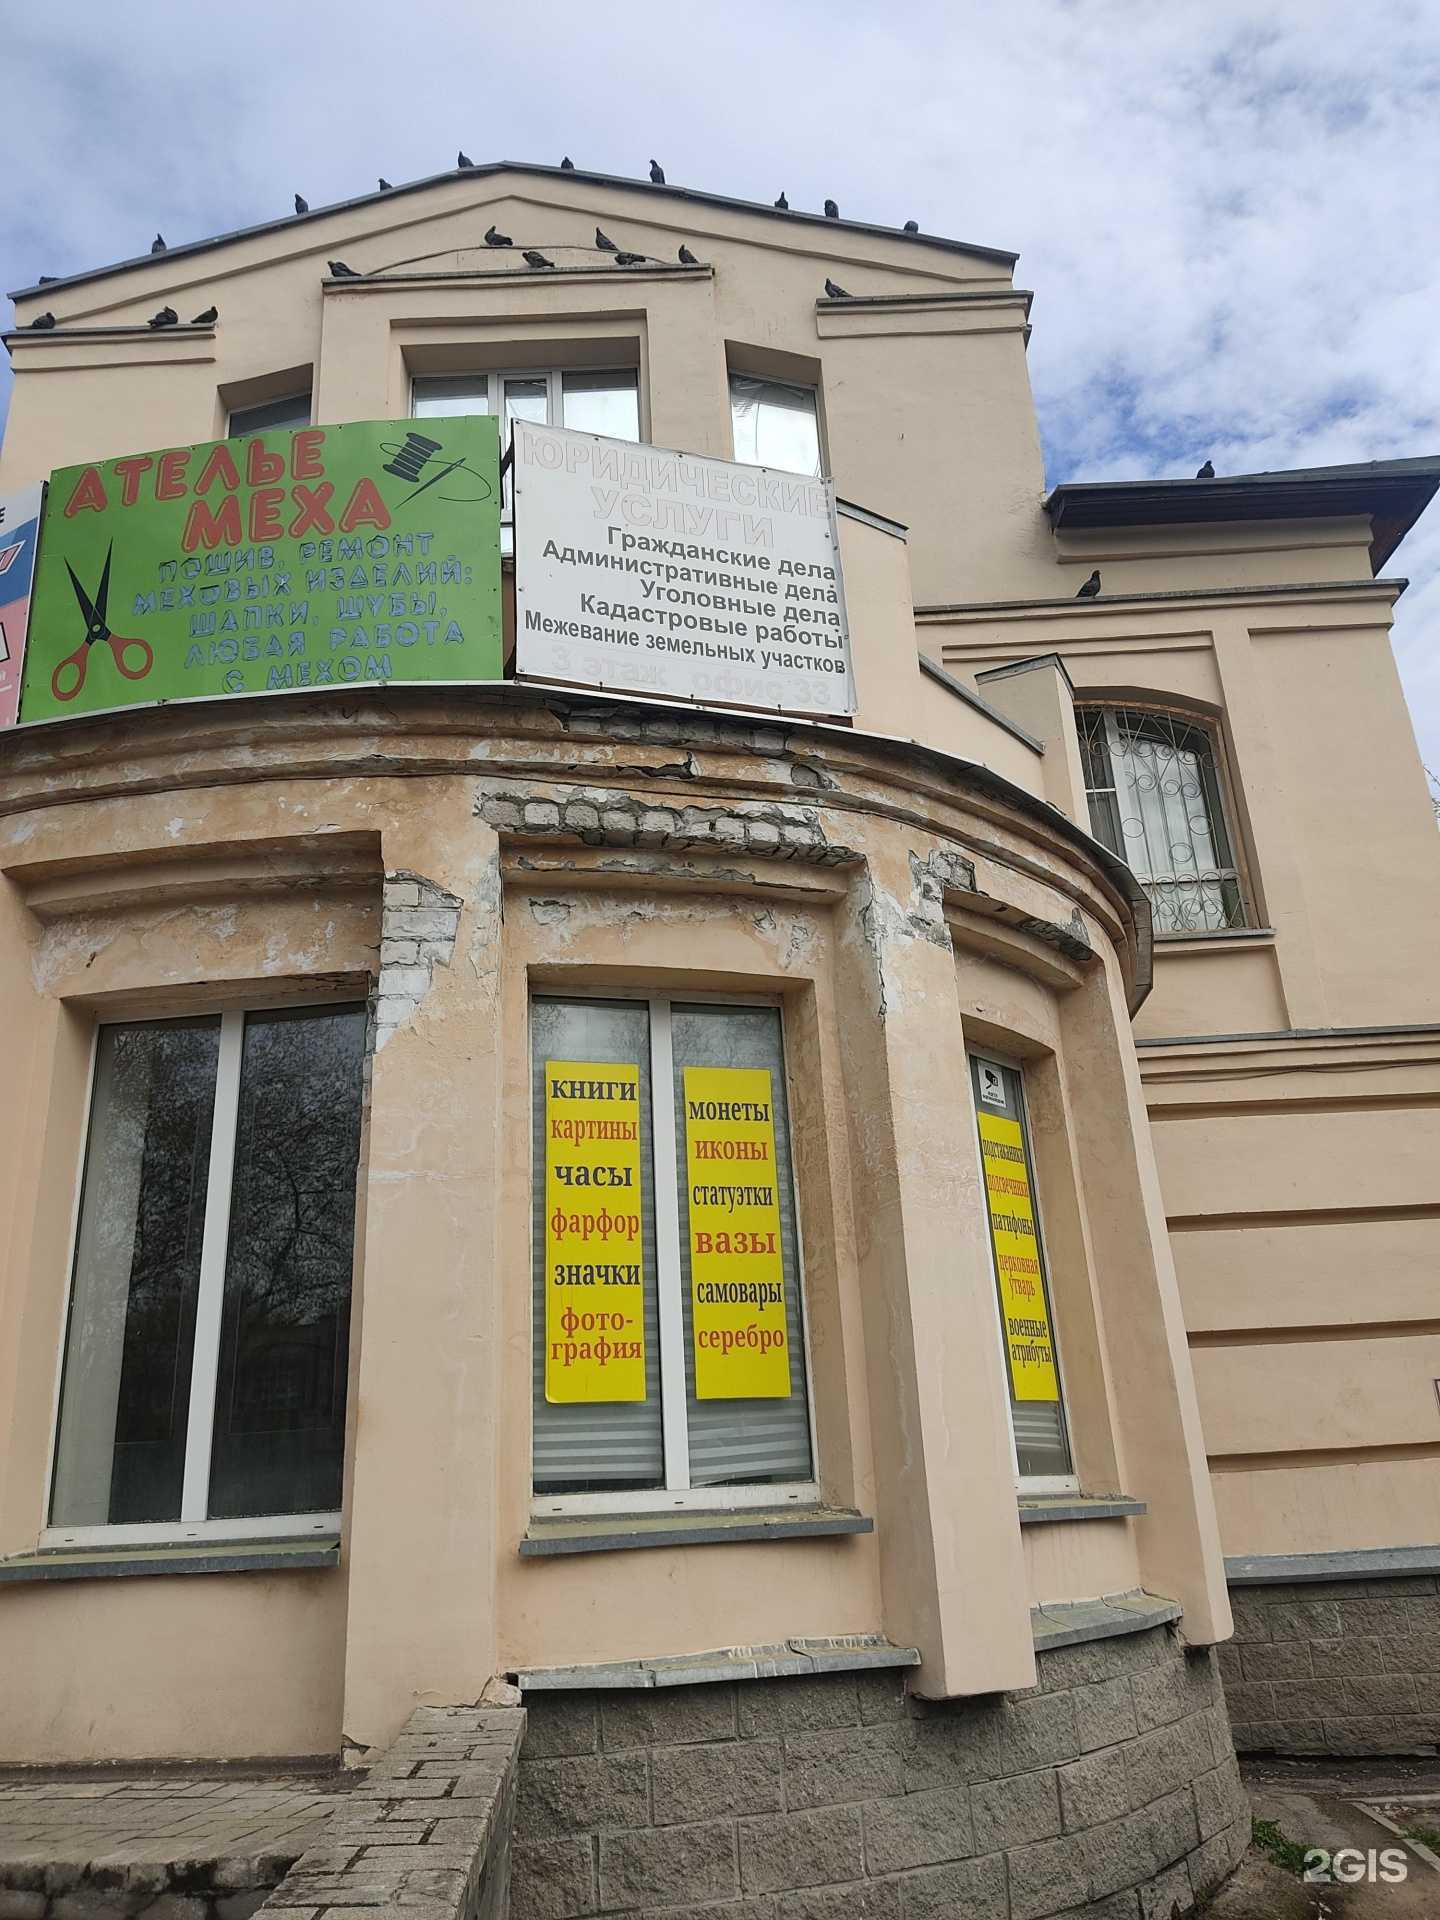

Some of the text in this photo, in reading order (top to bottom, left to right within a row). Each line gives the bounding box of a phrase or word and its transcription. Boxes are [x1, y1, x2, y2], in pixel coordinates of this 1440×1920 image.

[64, 430, 327, 519] АТЕЛЬЕ
[522, 431, 830, 519] ЮРИДИЧЕСКИЕ
[181, 477, 392, 553] МЕХА
[590, 485, 774, 549] УСЛУГИ
[300, 532, 434, 564] РЕМОНТ
[607, 526, 836, 581] Гражданские дела
[132, 555, 472, 616] МЕХОВЫХ ИЗДЕЛИЙ:
[542, 540, 838, 604] Административные дела
[640, 579, 841, 627] Уголовные дела
[580, 593, 844, 650] Кадастровые работы
[184, 620, 464, 669] ЛЮБАЯ РАБОТА
[525, 609, 846, 674] Межевание земельных участков
[222, 655, 393, 693] С МЕХОМ
[551, 1079, 637, 1102] книги
[689, 1101, 769, 1122] монеты
[551, 1119, 638, 1147] картины
[695, 1140, 768, 1161] иконы
[554, 1165, 633, 1187] часы
[693, 1184, 773, 1213] статуэтки
[551, 1208, 640, 1241] фарфор
[695, 1232, 777, 1254] вазы
[553, 1263, 641, 1286] значки
[998, 1254, 1040, 1277] церковная
[697, 1282, 783, 1312] самовары
[1008, 1278, 1036, 1302] утварь
[560, 1307, 634, 1338] фото-
[1008, 1317, 1048, 1338] военные
[551, 1337, 642, 1367] графия
[698, 1324, 784, 1355] серебро
[1011, 1339, 1052, 1368] атрибуты
